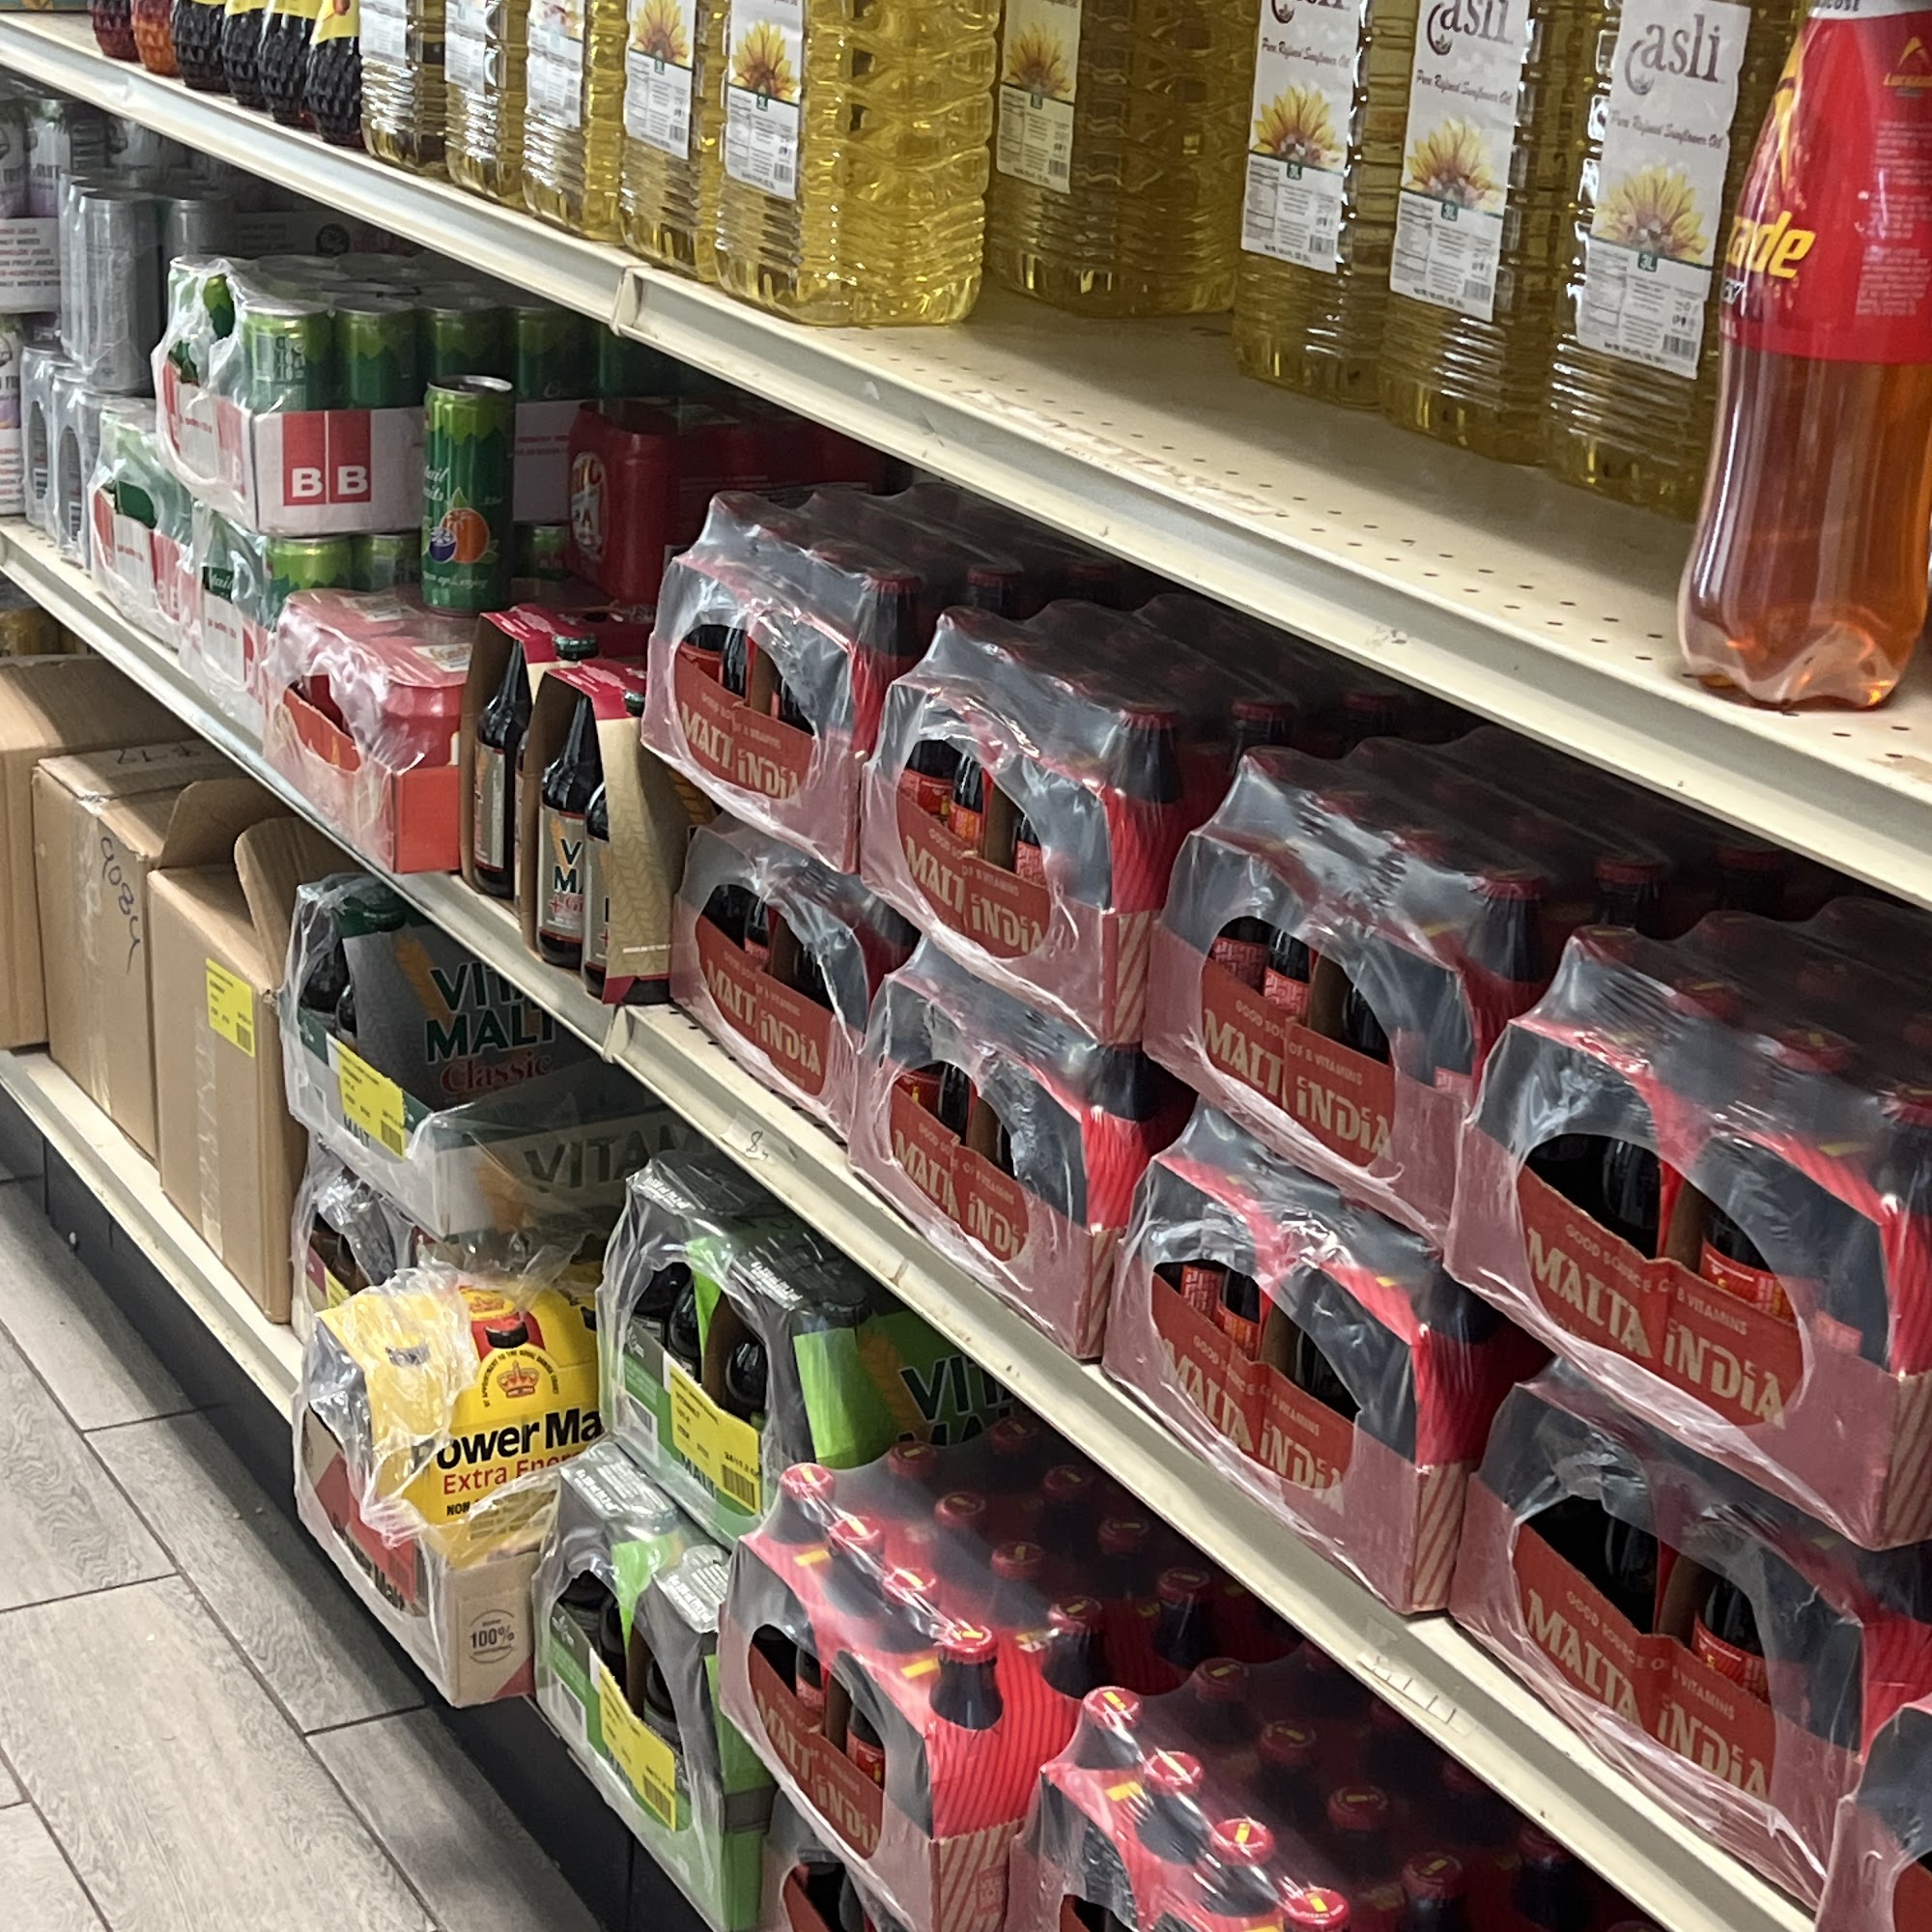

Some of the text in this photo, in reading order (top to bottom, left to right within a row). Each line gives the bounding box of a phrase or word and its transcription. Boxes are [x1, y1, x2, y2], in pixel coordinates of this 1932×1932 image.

[440, 1050, 553, 1094] Classic
[1527, 1226, 1654, 1359] MALTA
[437, 1421, 541, 1470] ower
[443, 1465, 508, 1495] Extra
[469, 1624, 516, 1649] 100%
[1527, 1588, 1642, 1727] MALTA
